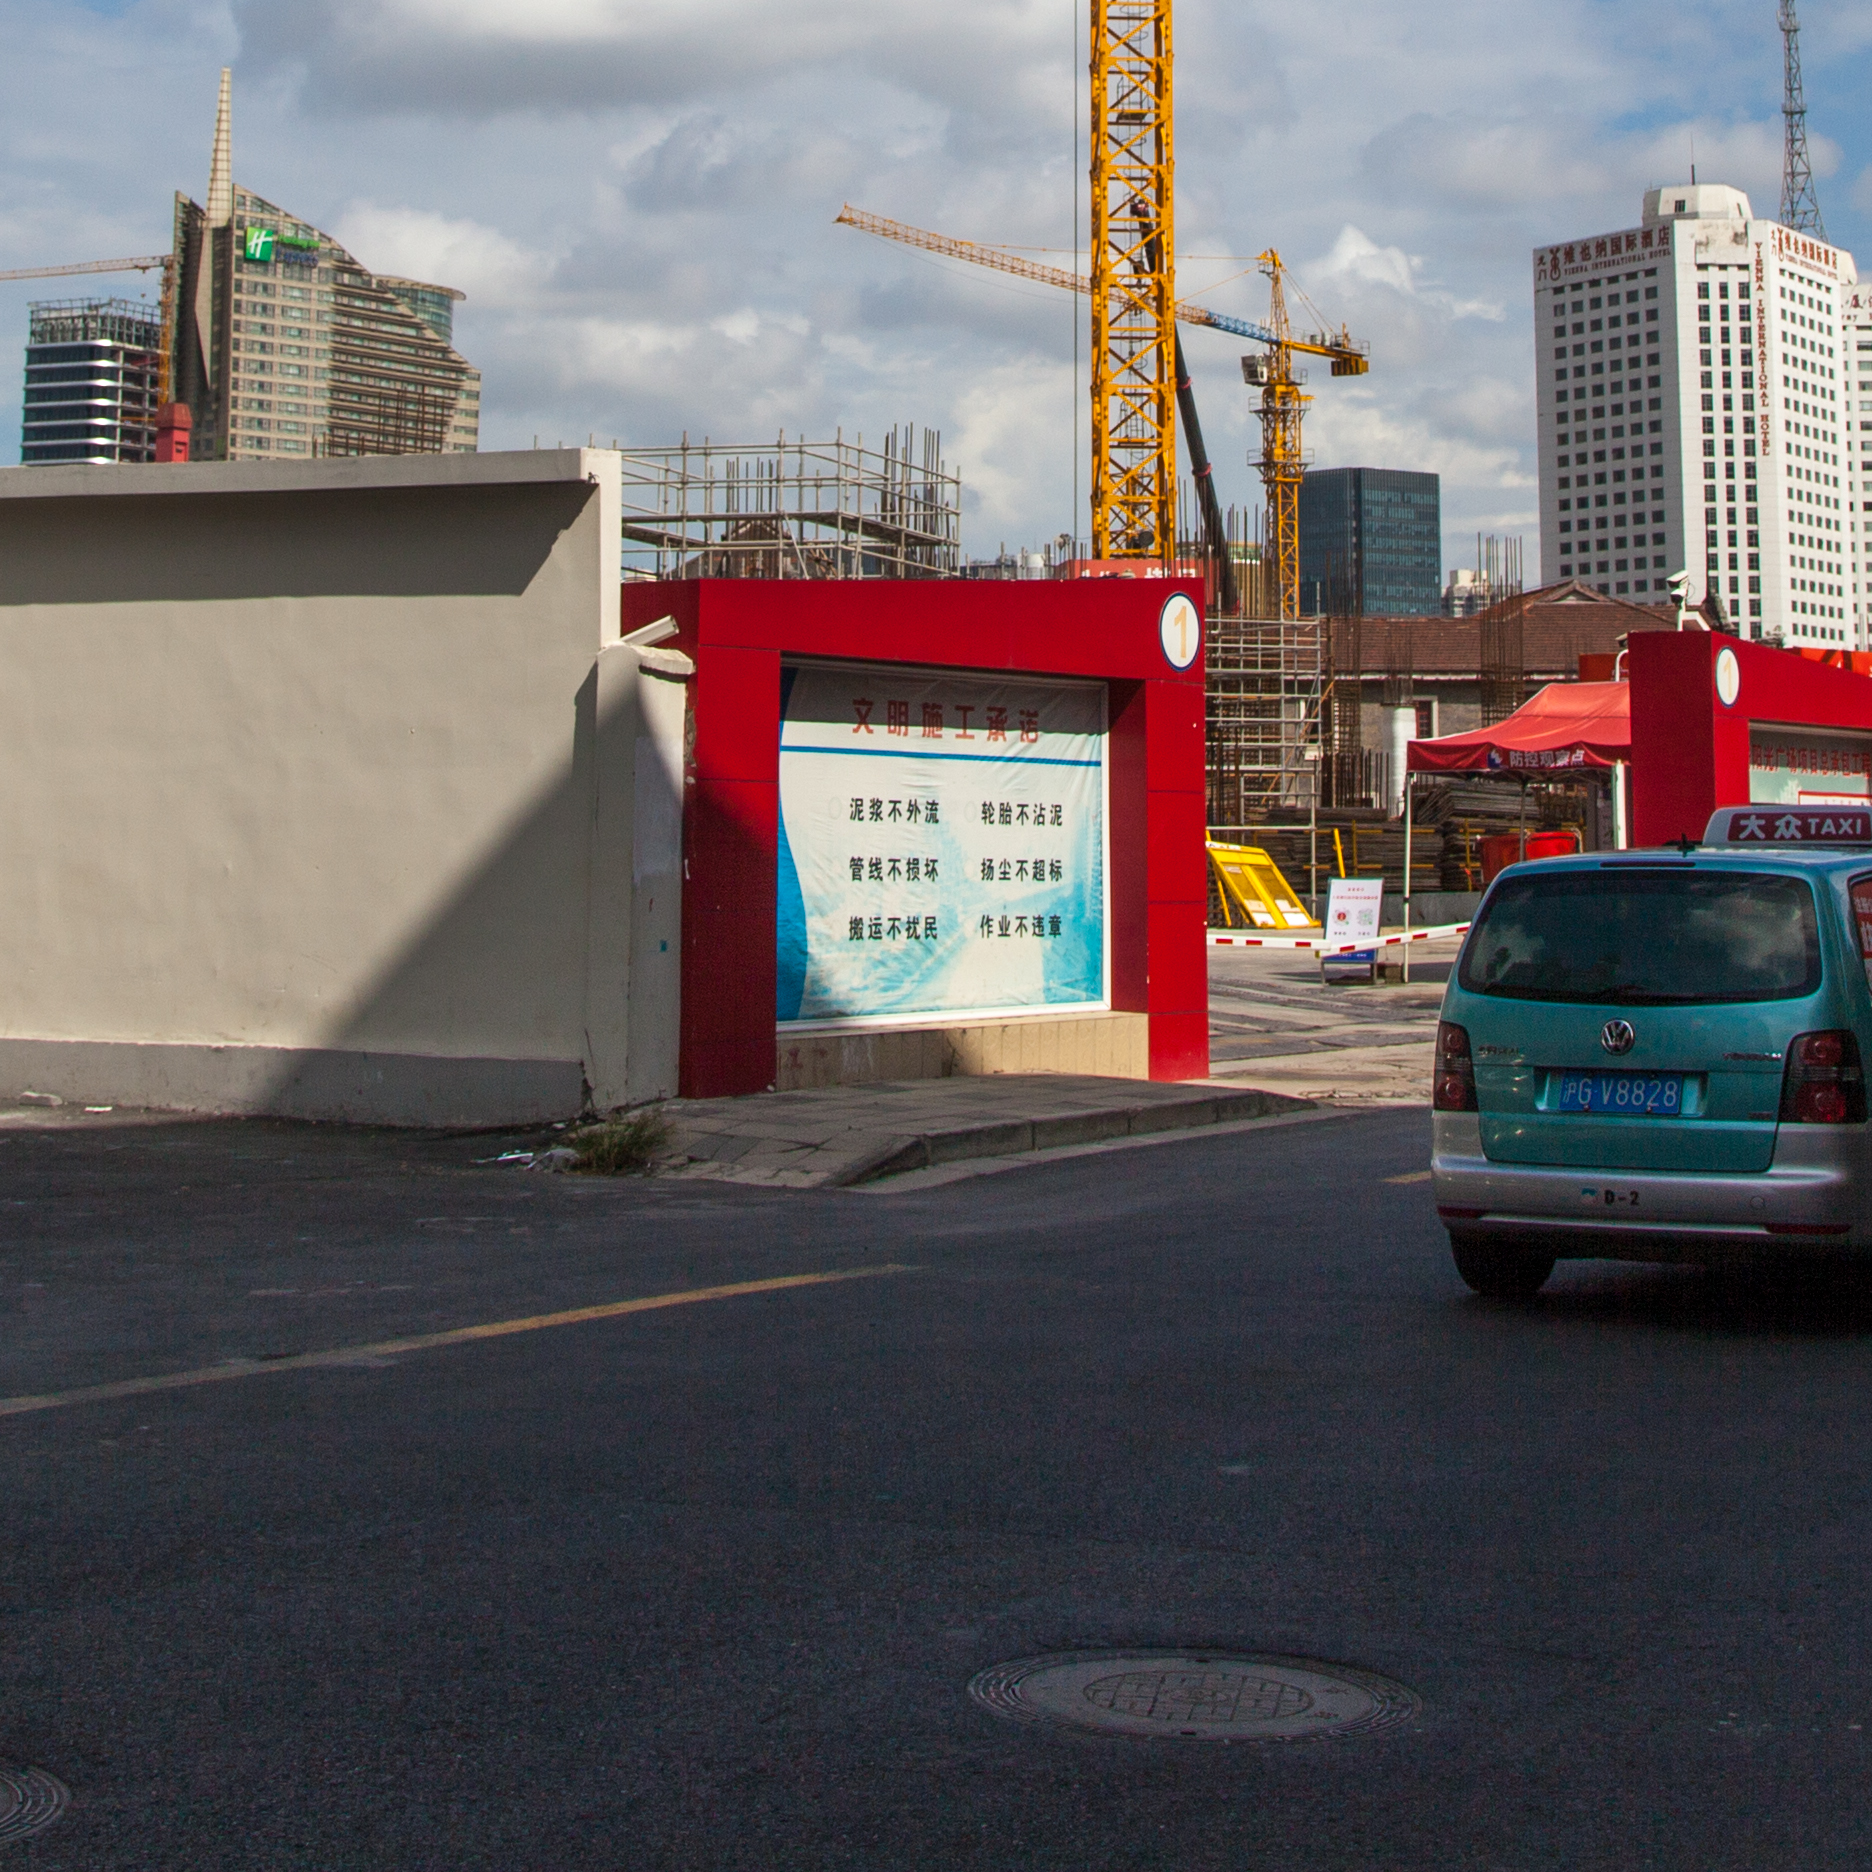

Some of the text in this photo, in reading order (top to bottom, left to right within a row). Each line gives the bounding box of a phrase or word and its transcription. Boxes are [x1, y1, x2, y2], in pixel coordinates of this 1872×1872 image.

[1563, 226, 1670, 265] 维也纳国际酒店
[1591, 254, 1646, 269] INTERNATIONAL
[1755, 242, 1770, 456] VIENNA INTERNATIONAL HOTEL
[852, 697, 1040, 744] 文明施工承诺
[1509, 749, 1585, 768] 防控观察点
[849, 797, 940, 824] 泥浆不外流
[981, 801, 1063, 826] 轮胎不沾泥
[1739, 814, 1861, 839] 大众 TAXI
[849, 856, 939, 882] 管线不损坏
[981, 858, 1063, 882] 扬尘不超标
[848, 916, 938, 941] 搬运不扰民
[980, 914, 1062, 939] 作业不违章
